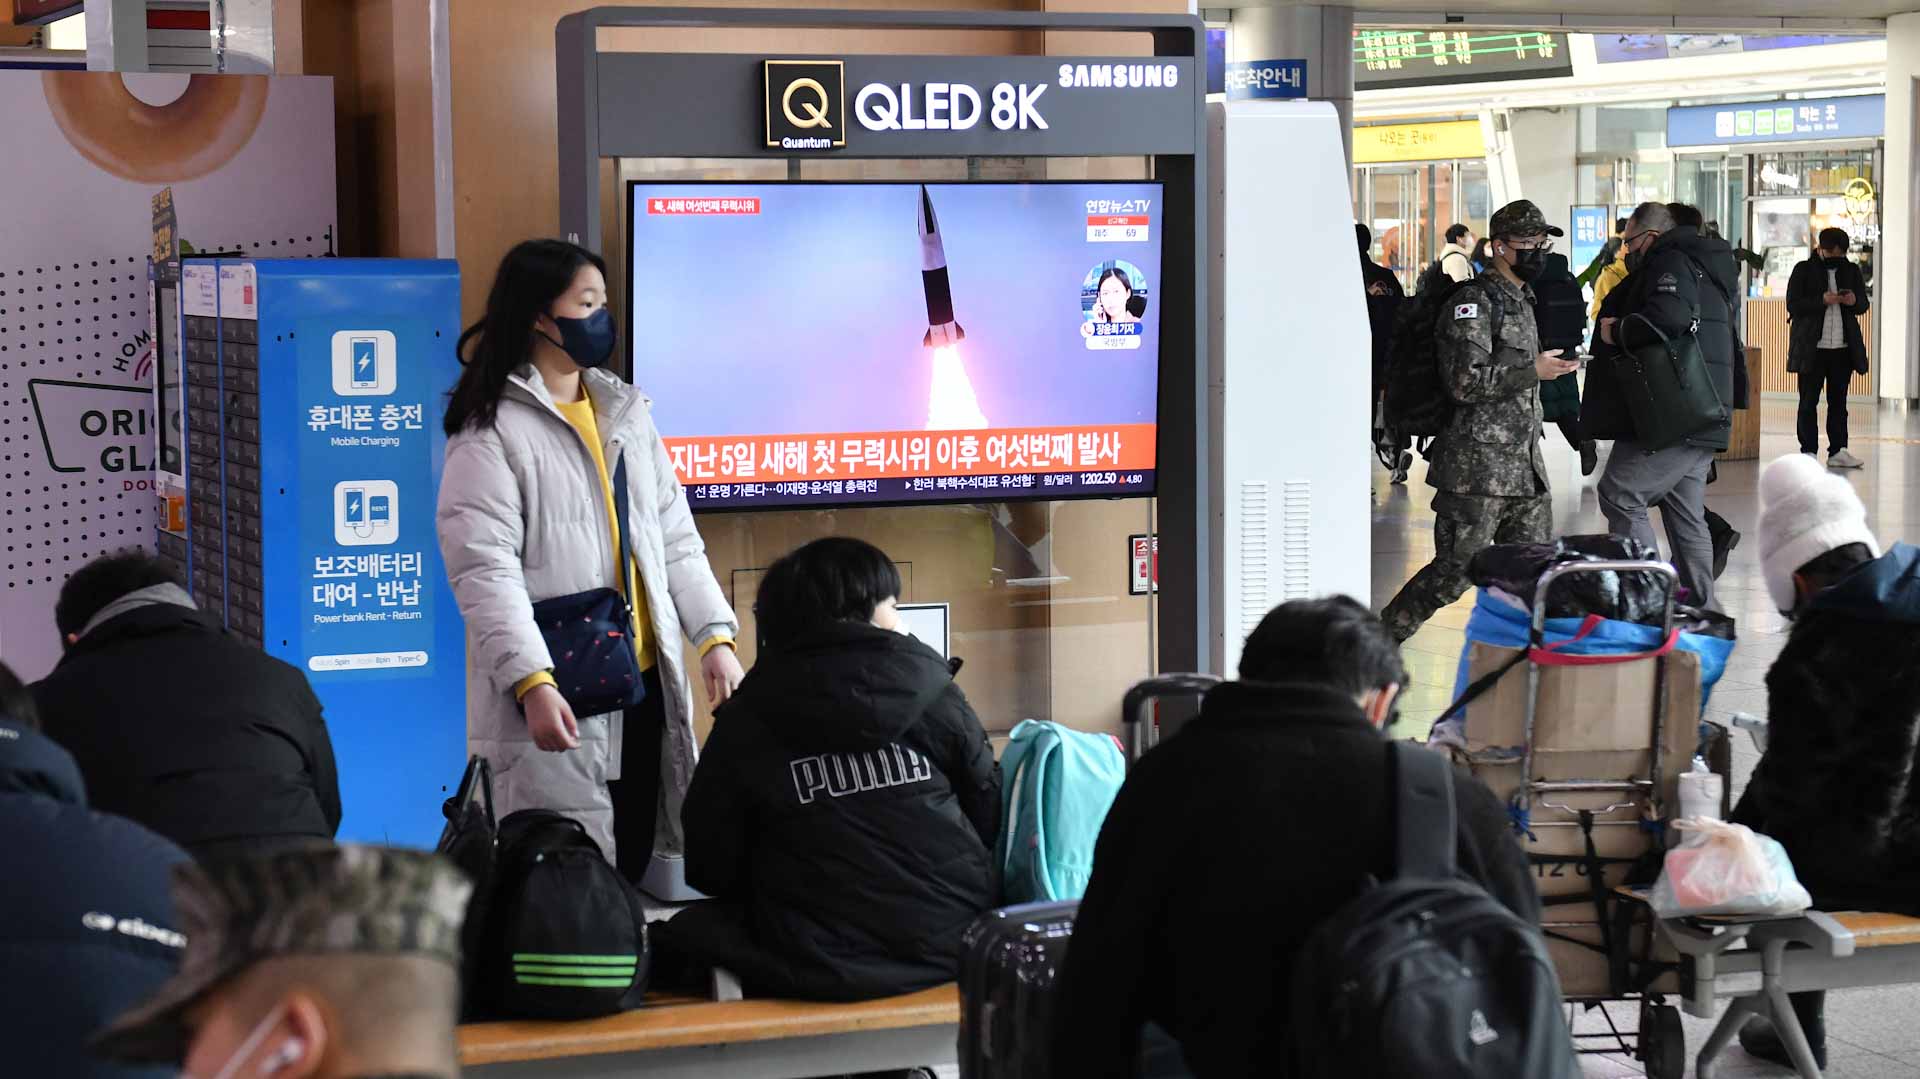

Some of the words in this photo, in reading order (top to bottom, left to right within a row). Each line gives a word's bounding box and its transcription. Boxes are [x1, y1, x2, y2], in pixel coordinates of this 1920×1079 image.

[1058, 64, 1178, 88] SAMSUNG
[782, 78, 832, 128] Q
[855, 83, 982, 130] QLED
[990, 83, 1049, 130] 8K
[782, 137, 831, 149] Quantum
[667, 200, 685, 212] 새해
[685, 200, 720, 212] 여섯번째
[721, 200, 755, 212] 무력시위
[1086, 199, 1151, 213] 연합뉴스TV
[1126, 228, 1137, 238] 69
[1119, 323, 1135, 334] 기자
[80, 409, 155, 436] ORI
[307, 405, 374, 431] 휴대폰
[378, 404, 423, 430] 충전
[331, 437, 360, 446] Mobile
[361, 436, 400, 447] Charging
[100, 446, 156, 472] GL
[670, 443, 717, 478] 지난
[720, 442, 756, 477] 5일
[761, 441, 808, 476] 새해
[813, 439, 835, 475] 첫
[840, 437, 930, 473] 무력시위
[936, 436, 980, 470] 이후
[986, 433, 1073, 468] 여섯번째
[1077, 431, 1122, 465] 발사
[695, 487, 706, 498] 선
[708, 486, 731, 498] 운명
[845, 480, 877, 493] 총력전
[913, 478, 934, 491] 한러
[936, 476, 999, 490] 북핵수석대표
[1043, 474, 1073, 486] 원/달러
[1080, 472, 1117, 485] 1202.50
[1126, 474, 1143, 484] 4.80
[313, 552, 422, 578] 보조배터리
[313, 582, 357, 608] 대여
[377, 580, 422, 607] 반납
[314, 614, 341, 623] Power
[343, 612, 364, 622] bank
[366, 612, 386, 621] Rent
[393, 611, 422, 619] Return
[790, 742, 931, 804] PUMA
